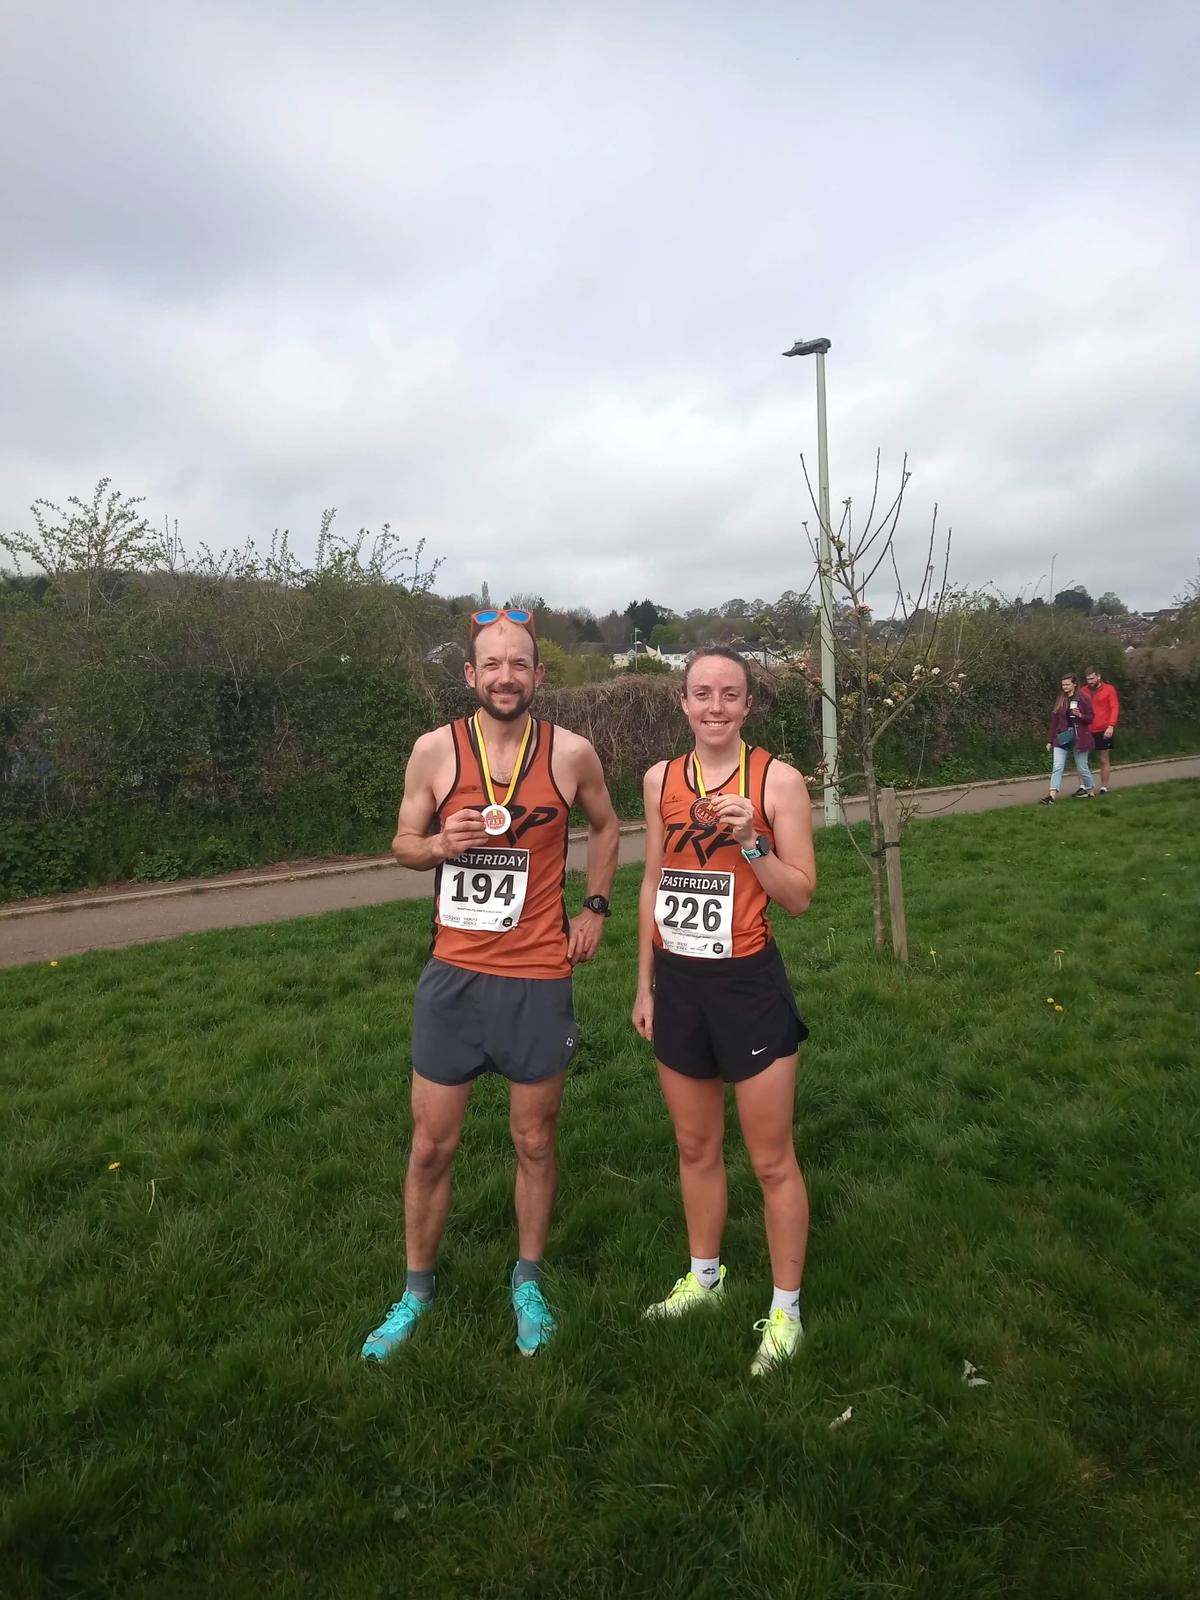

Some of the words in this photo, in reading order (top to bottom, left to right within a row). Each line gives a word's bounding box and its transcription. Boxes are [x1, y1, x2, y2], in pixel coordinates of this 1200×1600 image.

[451, 871, 516, 906] 194
[661, 875, 728, 891] FASTFRIDAY
[663, 895, 722, 932] 226
